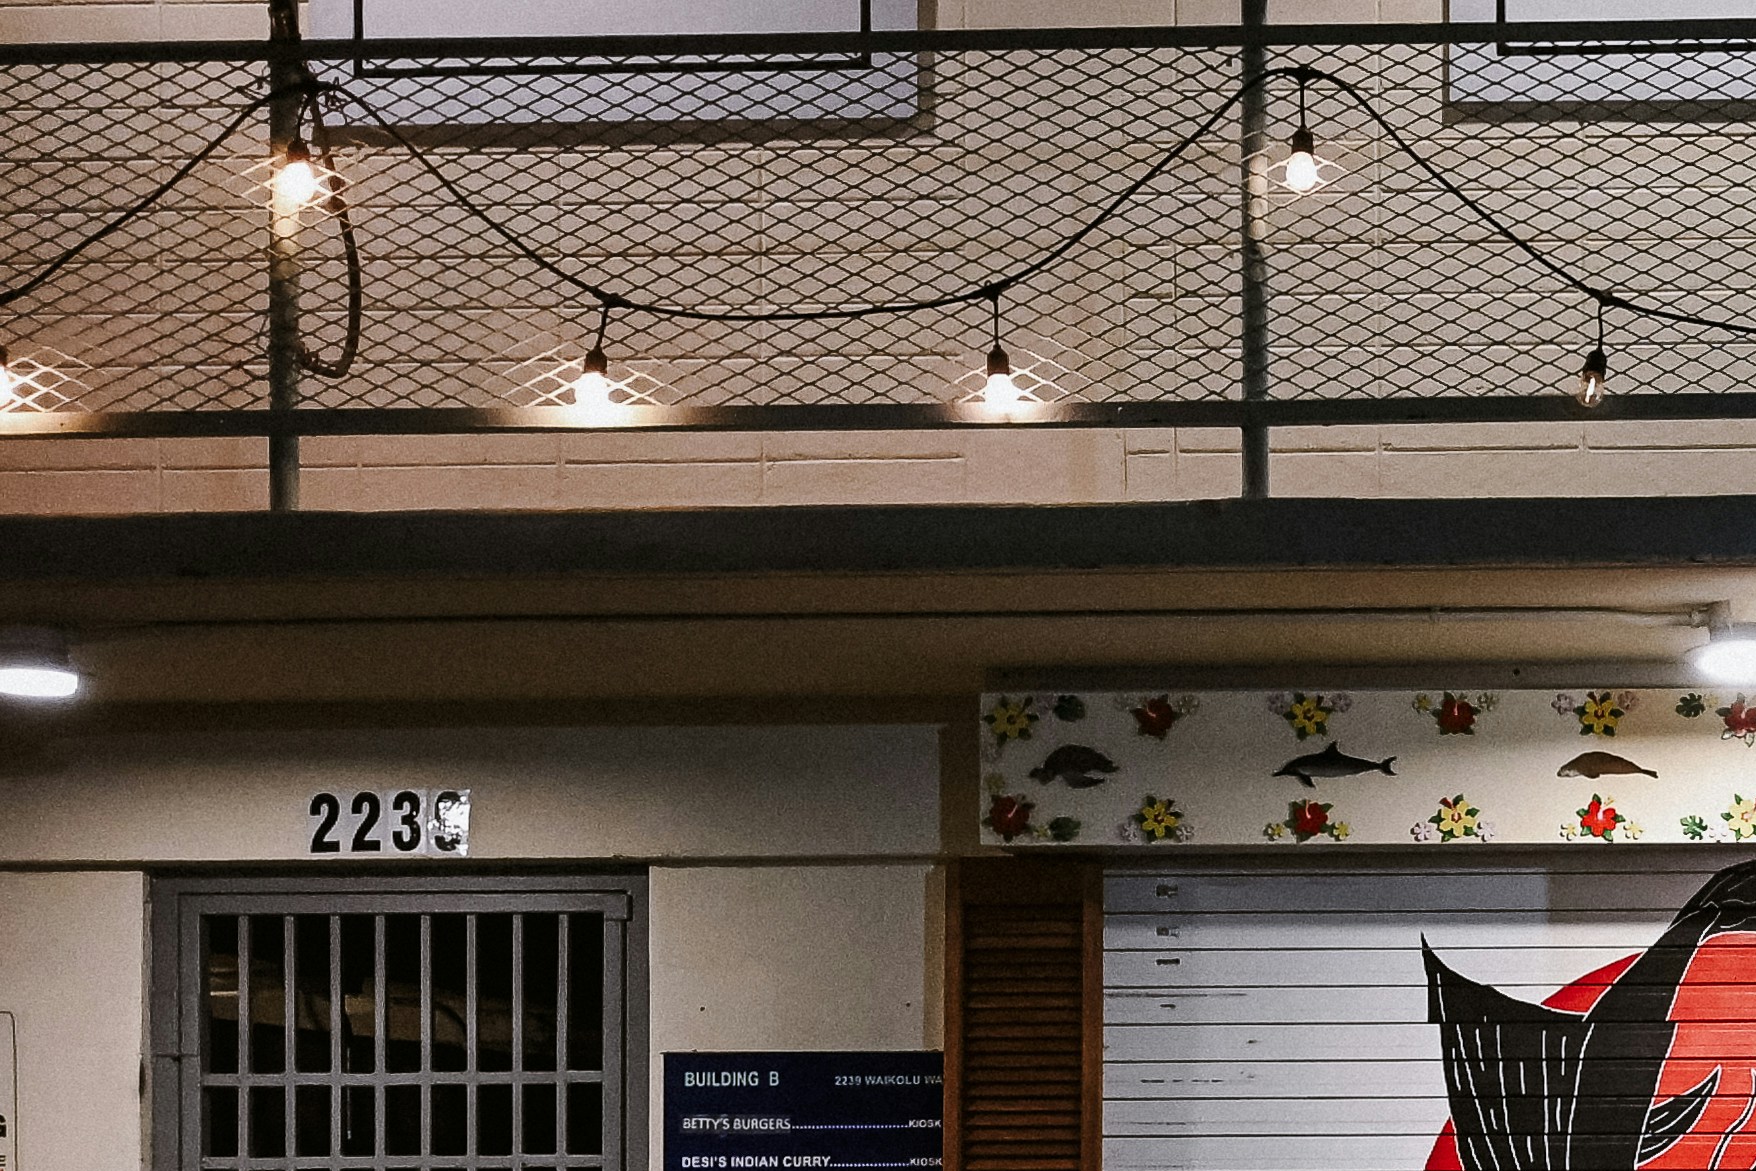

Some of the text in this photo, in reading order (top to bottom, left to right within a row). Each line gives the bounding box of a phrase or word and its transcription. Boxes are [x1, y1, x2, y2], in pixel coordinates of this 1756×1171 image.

[684, 1071, 780, 1087] BUILDING B
[865, 1074, 921, 1086] WAIKOLU
[682, 1117, 942, 1131] BETTY'S BURGERS KIOSK
[681, 1156, 942, 1168] DESI'S INDIAN CURRY KIOSK
